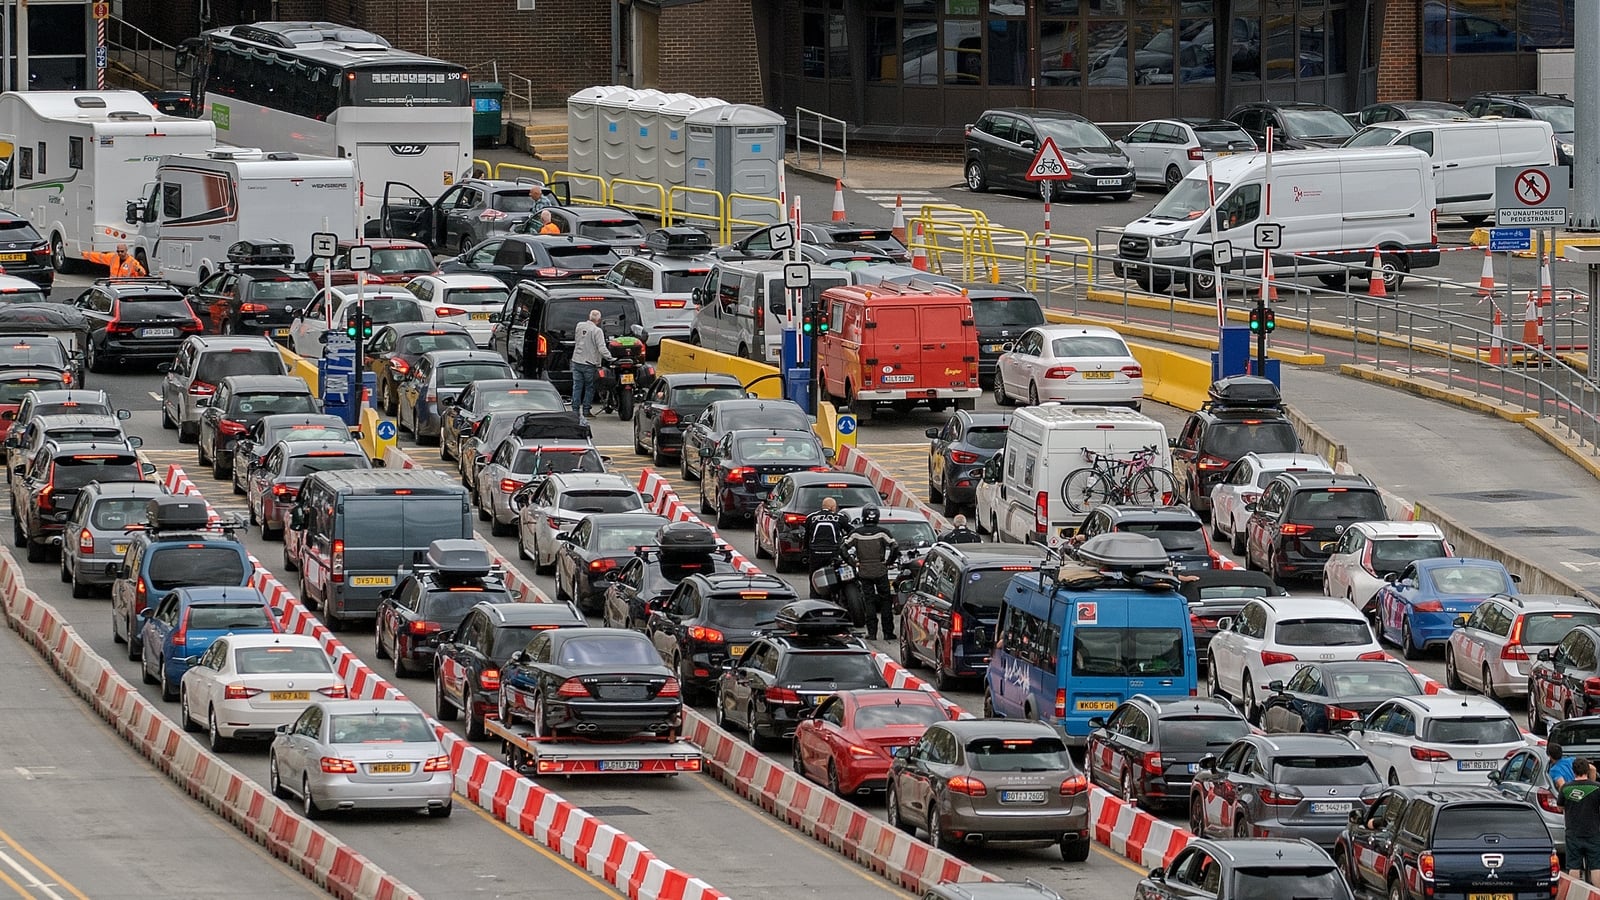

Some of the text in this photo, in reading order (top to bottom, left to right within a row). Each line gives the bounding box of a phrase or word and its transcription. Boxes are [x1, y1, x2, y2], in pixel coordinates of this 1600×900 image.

[447, 72, 460, 80] 190
[394, 145, 422, 153] VDL
[143, 154, 158, 162] Fors
[1512, 209, 1564, 217] UNAUTHORISED
[775, 231, 787, 241] K
[319, 240, 331, 251] H
[1080, 701, 1114, 709] WK06 YGH
